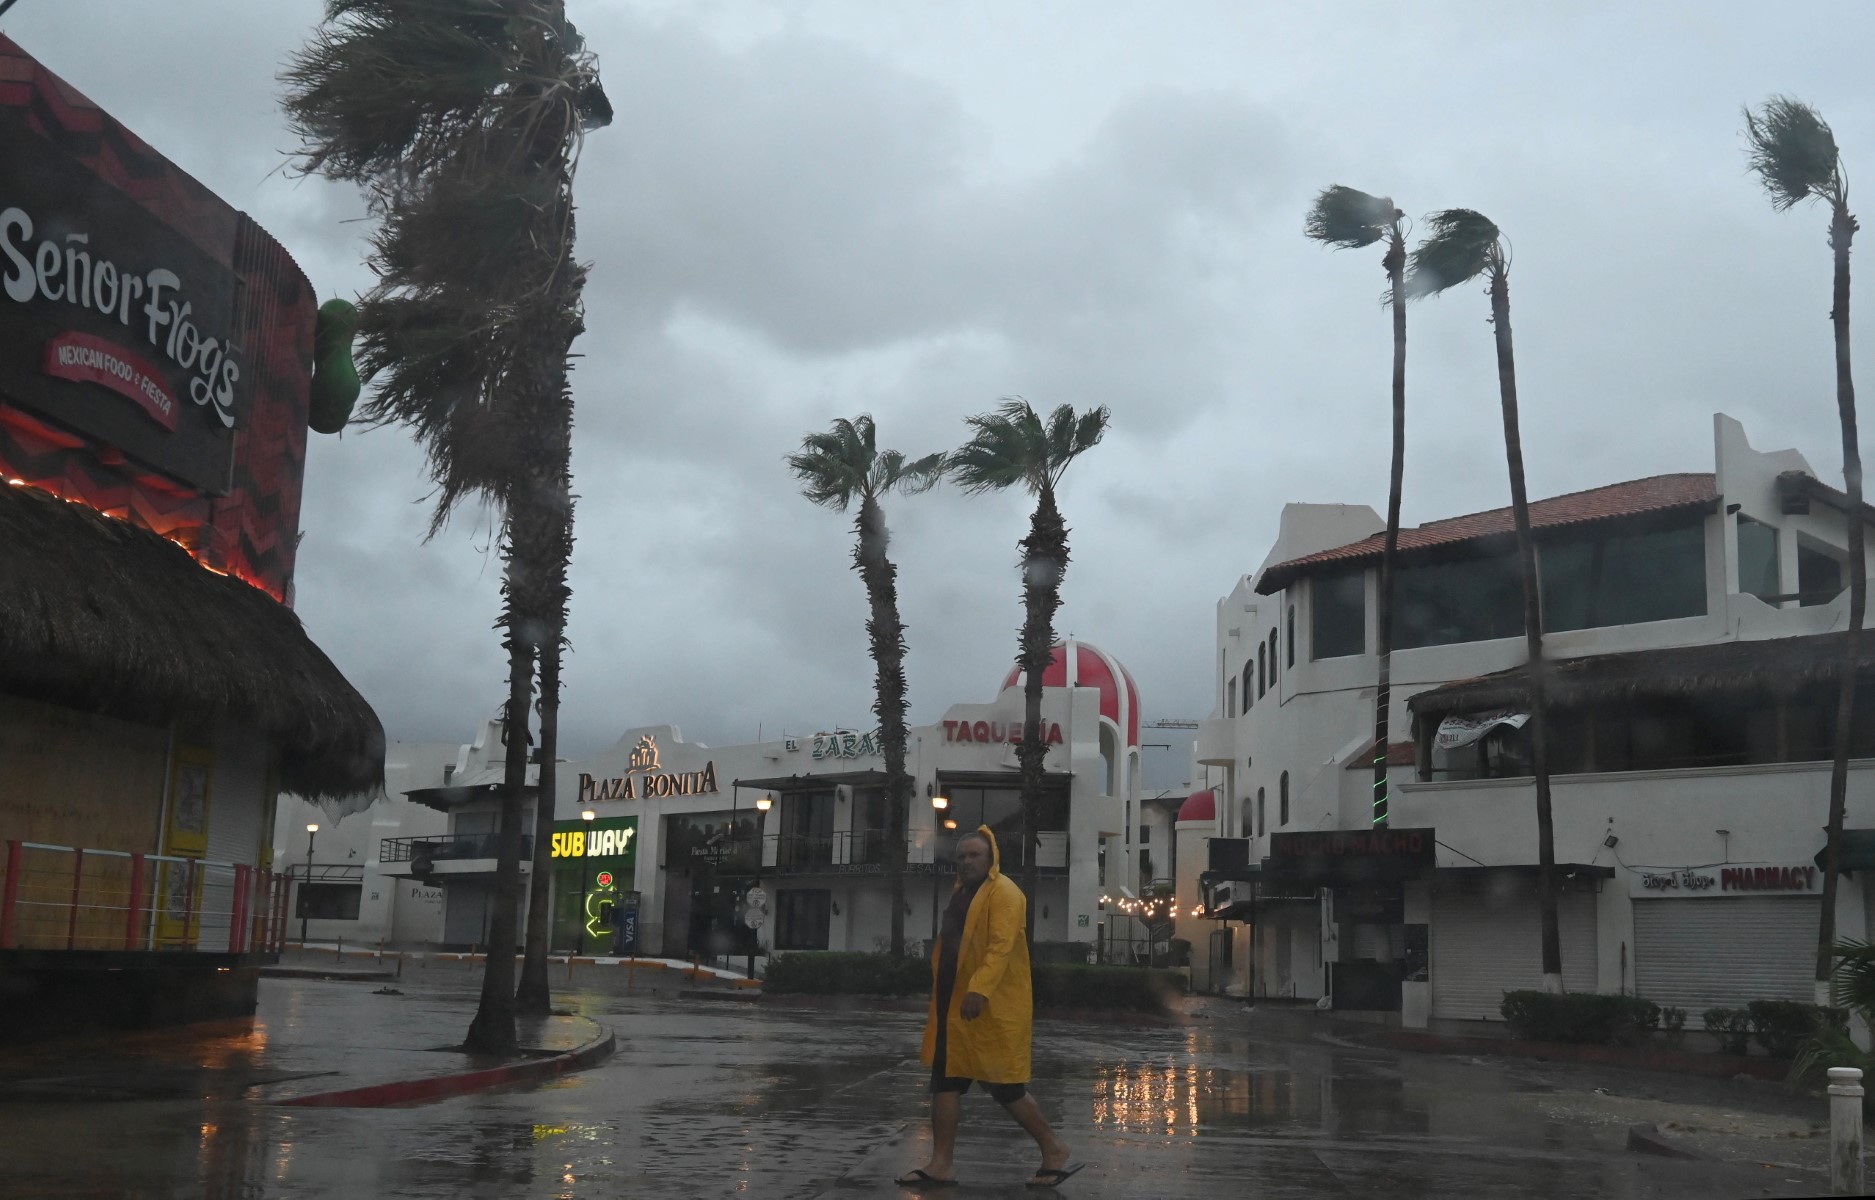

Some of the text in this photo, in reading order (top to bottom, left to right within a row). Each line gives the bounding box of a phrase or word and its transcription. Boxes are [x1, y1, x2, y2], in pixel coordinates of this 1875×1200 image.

[0, 207, 240, 428] Señor Frog's
[58, 345, 104, 370] MEXICAN
[104, 354, 133, 382] FOOD
[140, 375, 172, 416] FIESTA
[943, 717, 1063, 744] TAQUEÍA
[785, 739, 797, 750] EL
[577, 761, 718, 802] PLAZA BONITA
[551, 826, 634, 858] SUBWAY
[1721, 866, 1815, 890] PHARMACY
[412, 888, 442, 898] PLAZA
[625, 916, 635, 943] VISA
